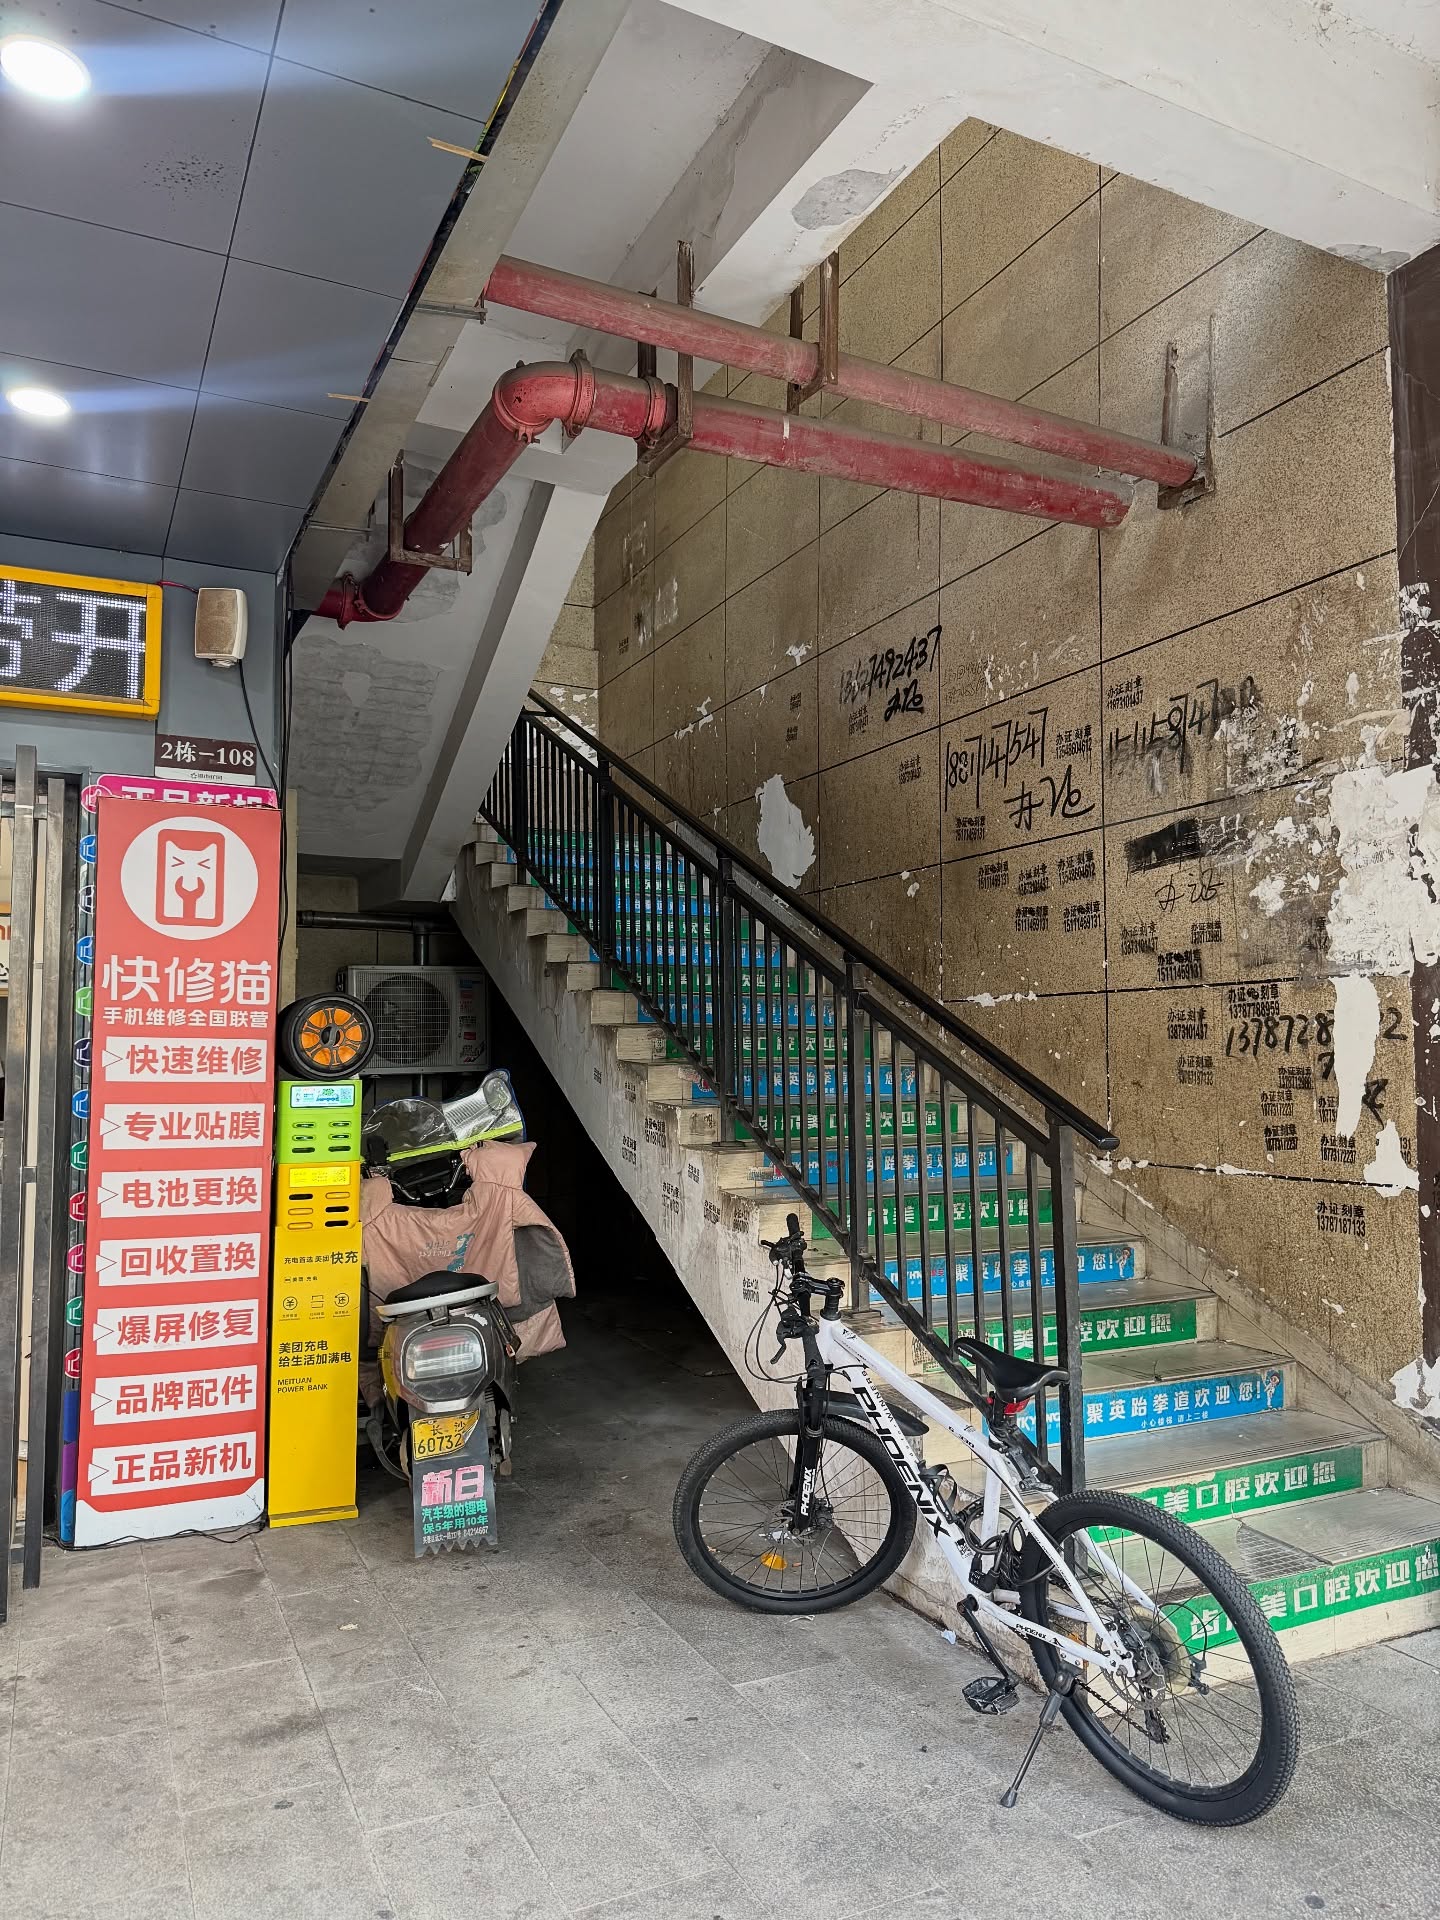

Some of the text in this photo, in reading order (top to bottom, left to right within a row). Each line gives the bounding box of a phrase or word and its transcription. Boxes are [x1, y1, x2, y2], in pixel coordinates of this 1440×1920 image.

[102, 955, 272, 1005] 快修猫
[103, 1007, 269, 1029] 手机维修全国联营
[126, 1044, 263, 1076] 快速维修
[124, 1111, 260, 1142] 专业贴膜
[122, 1176, 258, 1208] 电池更换
[1316, 1201, 1365, 1218] 办证刻章
[1317, 1215, 1366, 1237] 13787187133
[121, 1241, 256, 1277] 回收置换
[117, 1308, 254, 1346] 爆屏修复
[279, 1340, 329, 1354] 美团充电
[279, 1351, 352, 1368] 给生活加满电
[116, 1374, 253, 1415] 品牌配件
[277, 1377, 312, 1386] MEITUAN
[277, 1383, 328, 1394] POWER BANK
[417, 1433, 463, 1455] 60732
[112, 1441, 252, 1485] 正品新机
[852, 1386, 951, 1538] PHOENIX
[421, 1465, 486, 1507] 新日
[801, 1467, 814, 1516] PHOENIX
[1143, 1460, 1336, 1514] 美口腔欢迎您
[421, 1500, 488, 1523] 汽车级的锂电
[422, 1515, 489, 1535] 保5年用10年
[1190, 1547, 1439, 1640] 齿美口腔欢迎您
